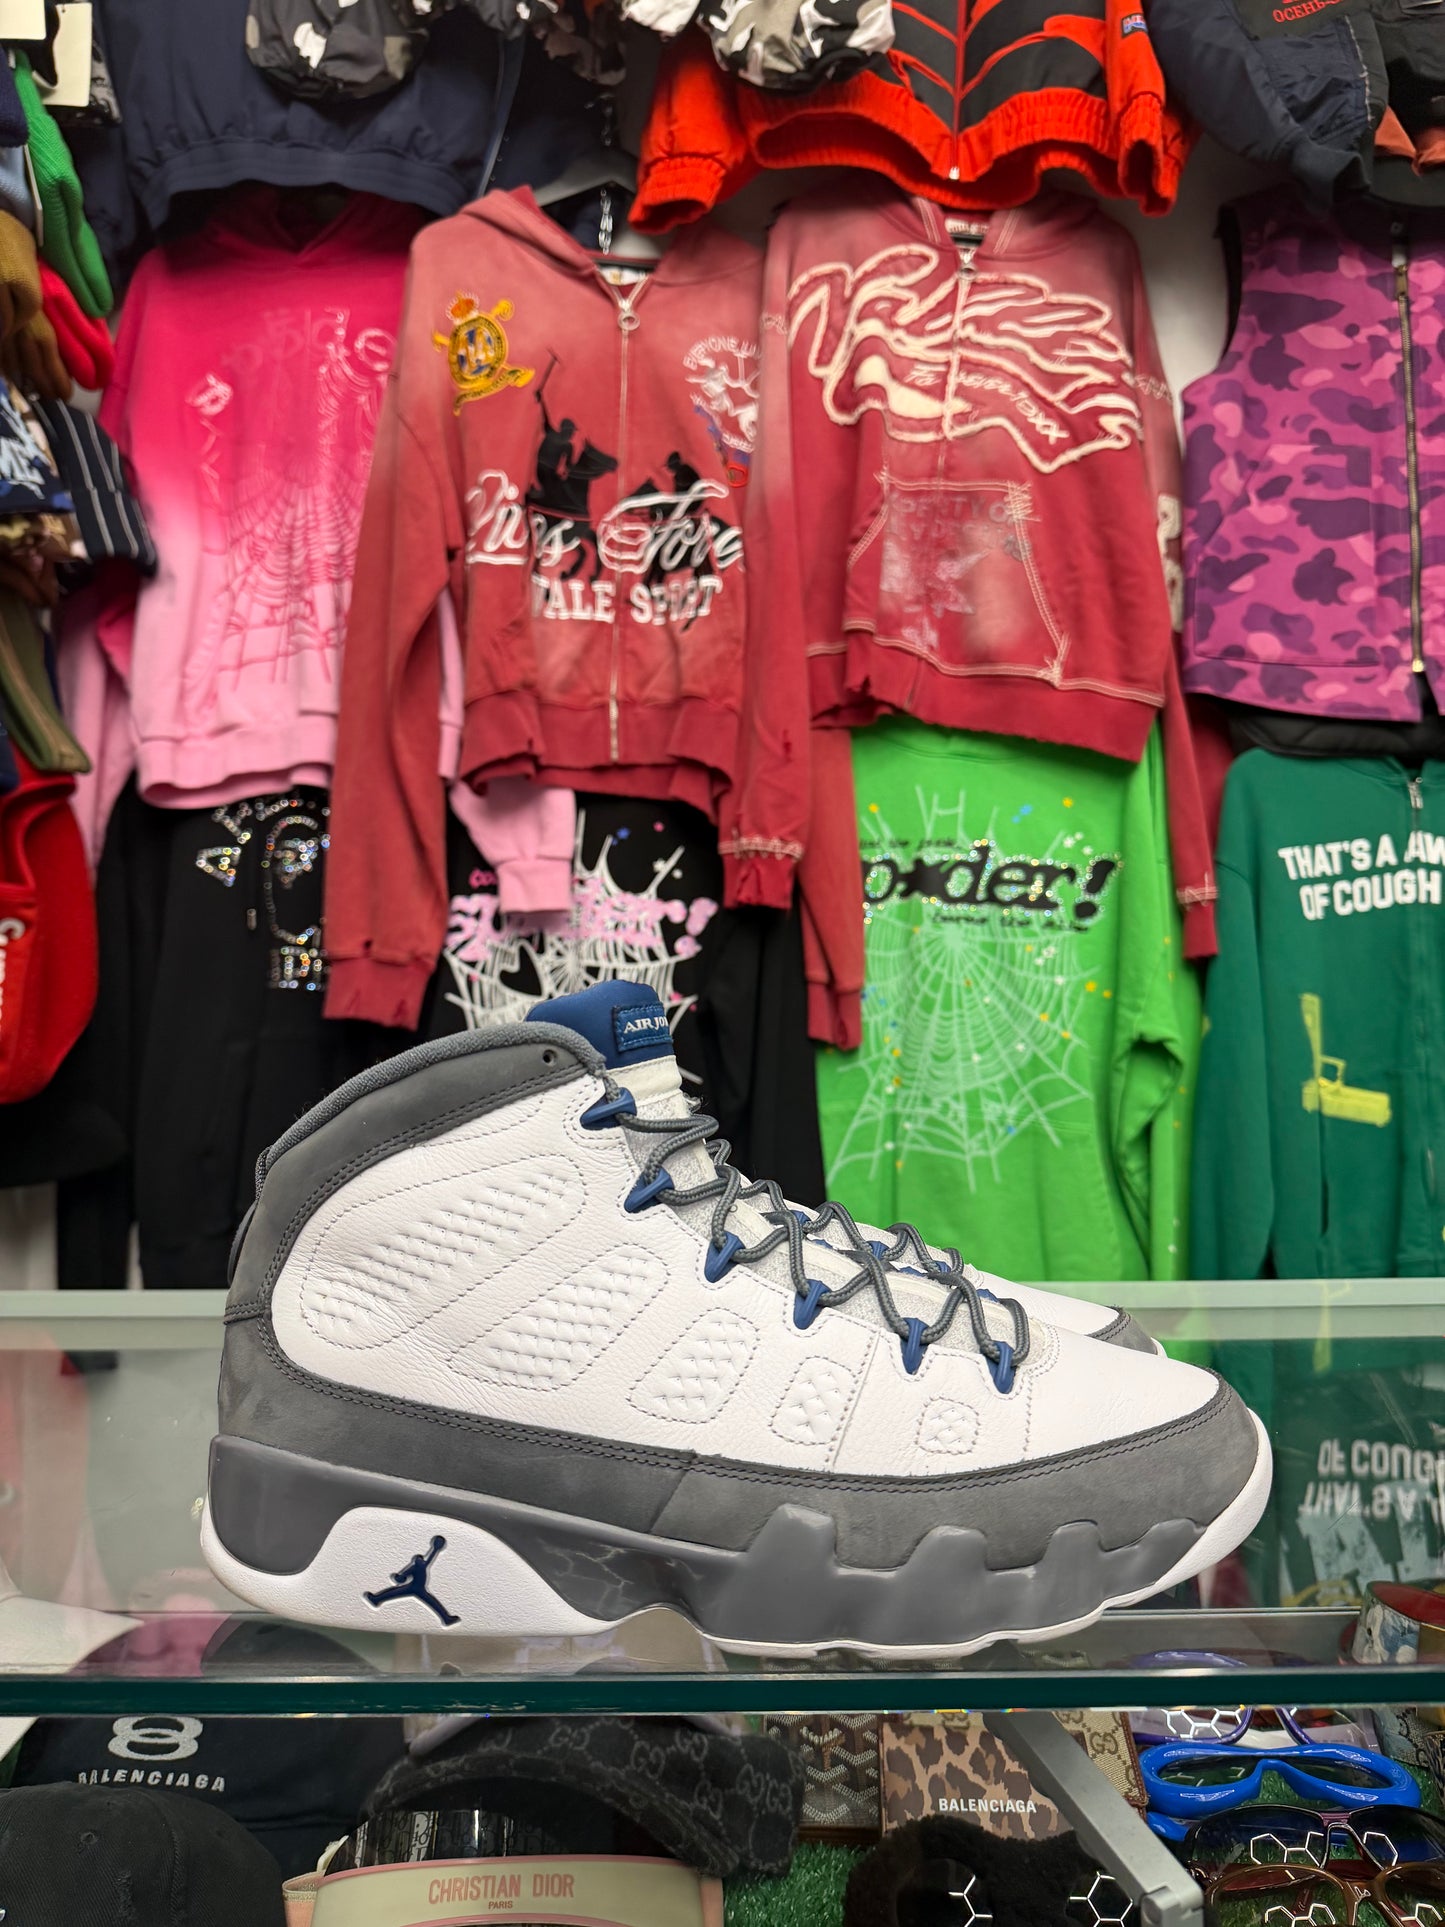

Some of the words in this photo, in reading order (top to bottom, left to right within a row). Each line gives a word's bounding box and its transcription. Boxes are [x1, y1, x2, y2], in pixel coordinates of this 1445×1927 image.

[1277, 837, 1372, 881] THAT'S
[1375, 833, 1398, 868] A
[1300, 882, 1330, 921] OF
[1332, 867, 1443, 917] COUGH
[623, 1018, 654, 1034] AIR
[938, 1797, 1038, 1815] BALENCIAGA
[428, 1873, 522, 1906] CHRISTIAN
[532, 1872, 575, 1899] DIOR
[487, 1900, 514, 1911] PARIS
